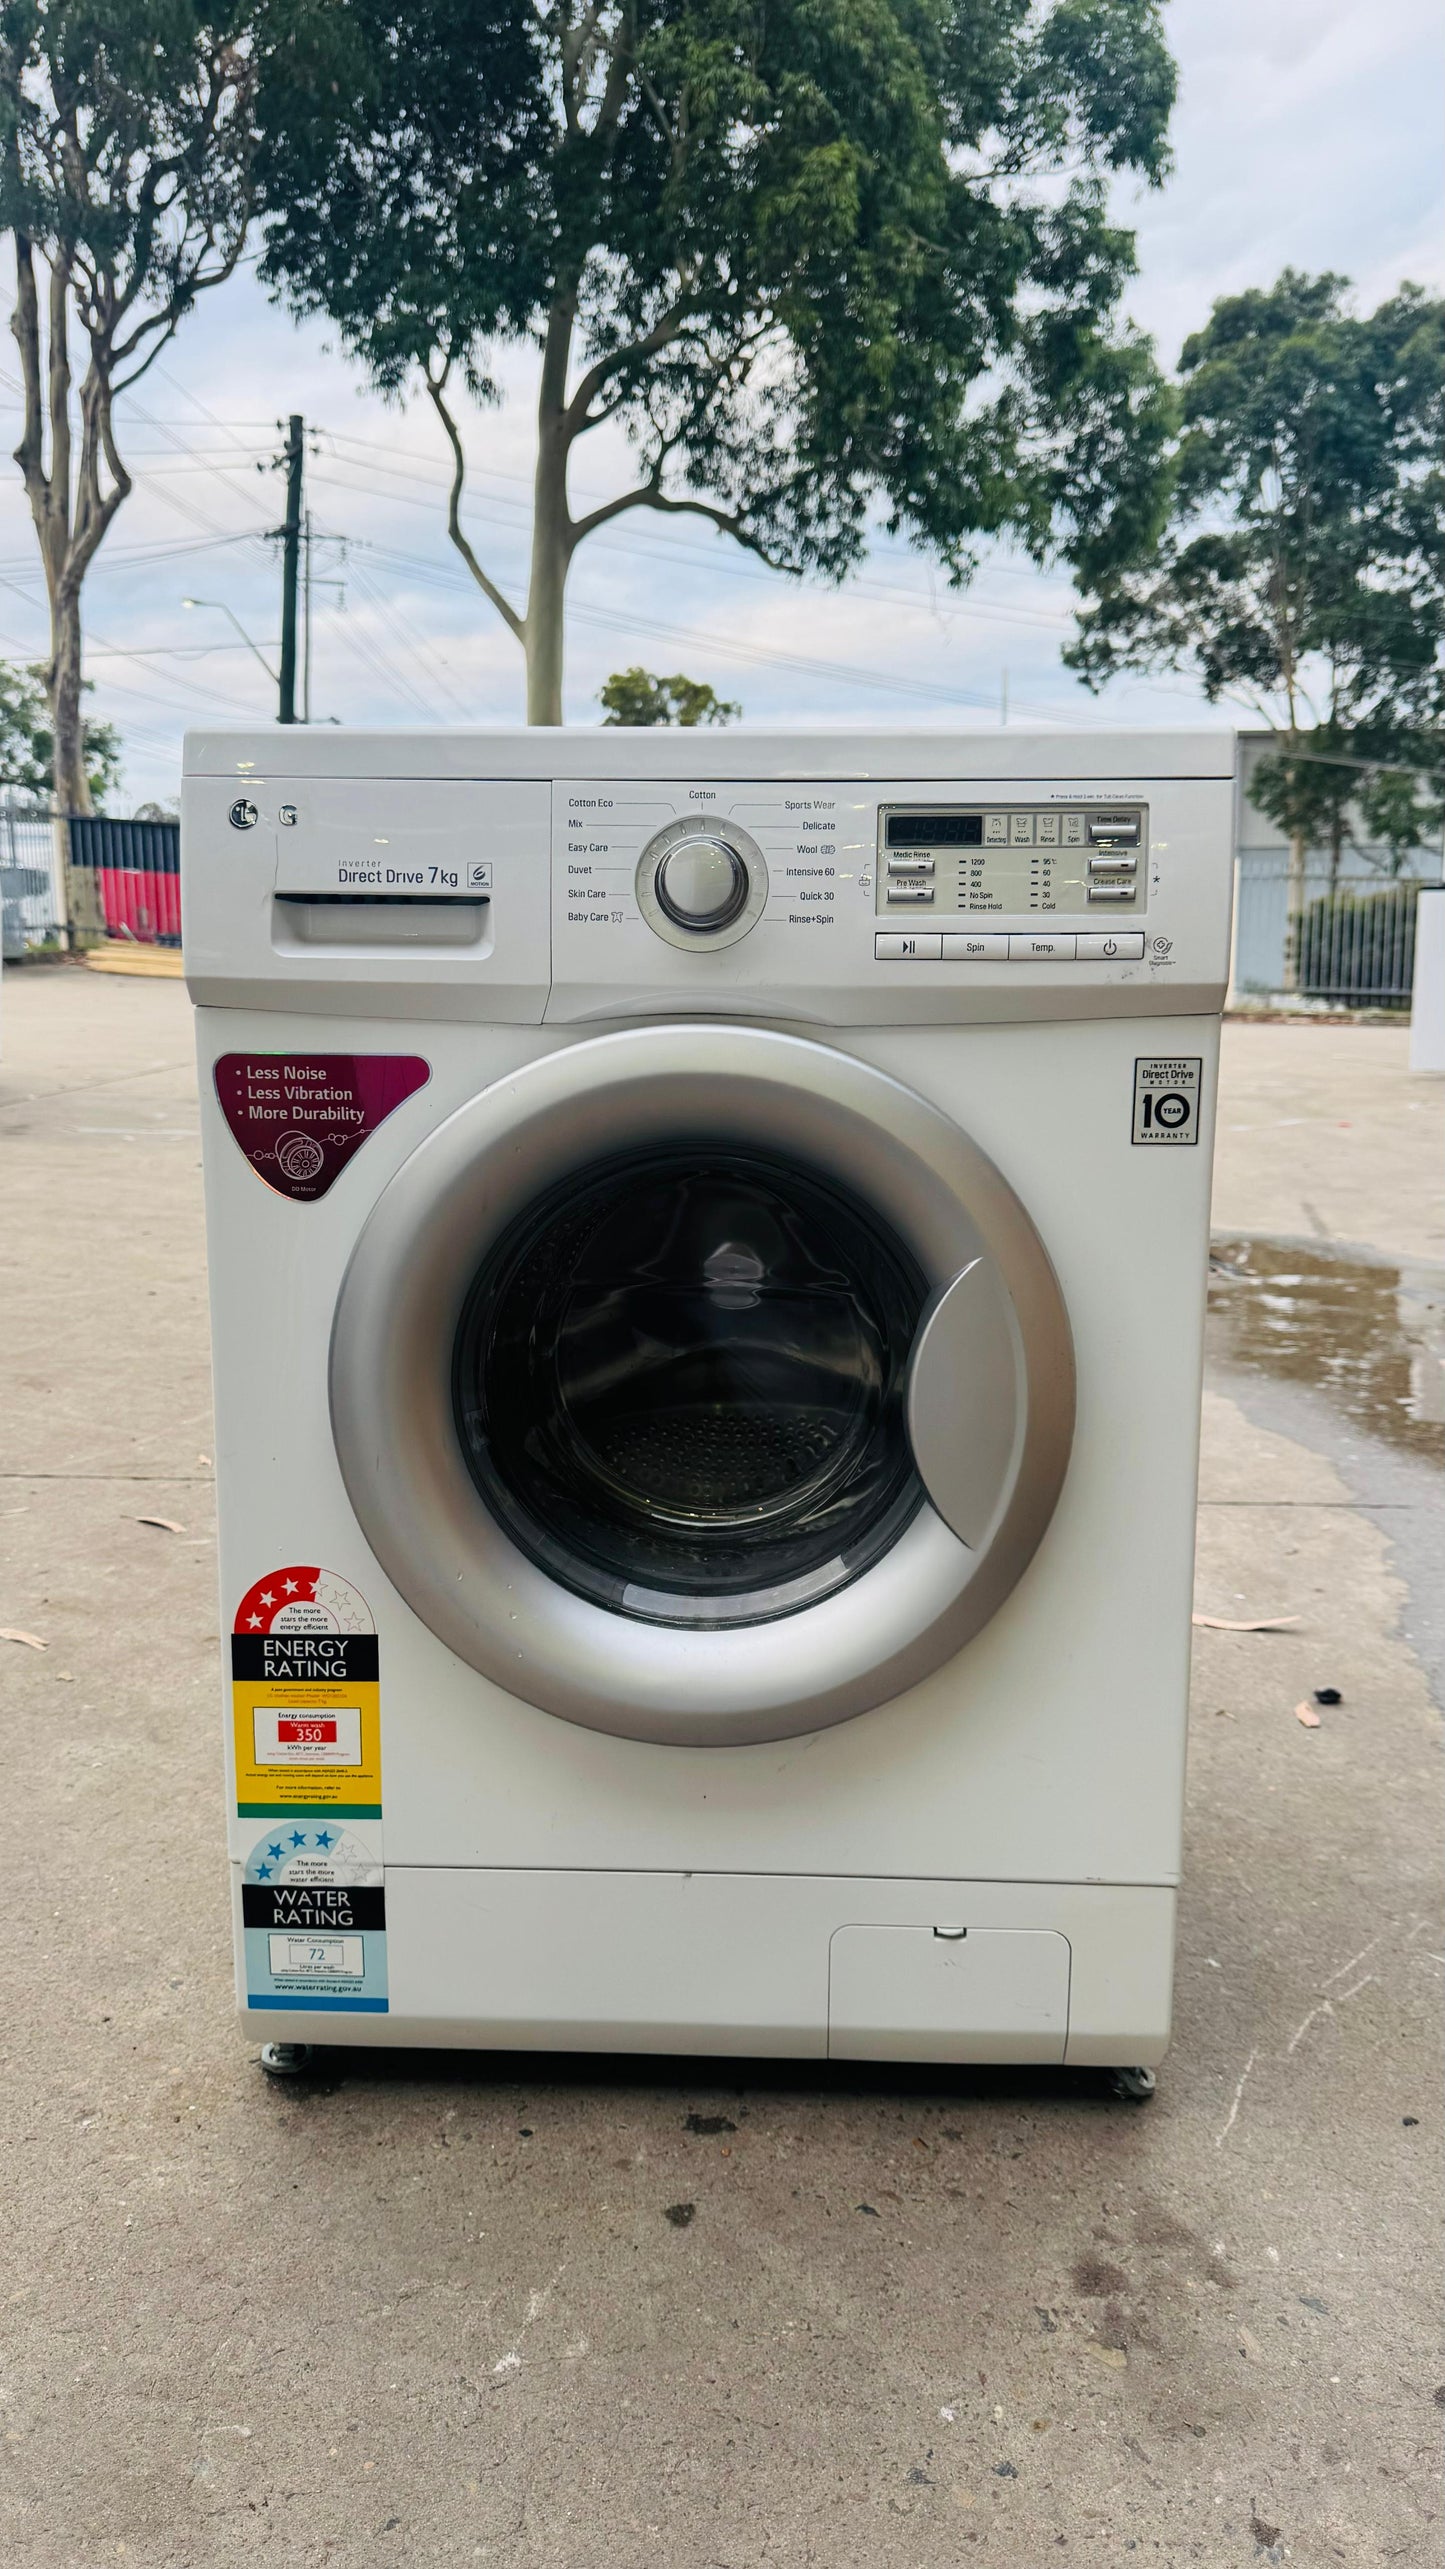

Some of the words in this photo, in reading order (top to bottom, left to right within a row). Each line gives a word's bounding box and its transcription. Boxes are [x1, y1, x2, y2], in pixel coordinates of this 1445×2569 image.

[689, 790, 716, 799] Cotton
[568, 799, 596, 808] Cotton
[598, 799, 613, 808] Eco
[785, 801, 812, 811] Sports
[813, 801, 835, 810] Wear
[568, 820, 583, 828] Mix
[1097, 815, 1112, 823] Time
[1113, 815, 1131, 824] Delay
[802, 821, 836, 831] Delicate
[568, 843, 588, 853] Easy
[589, 843, 608, 852] Care
[797, 845, 817, 854] Wool
[893, 851, 912, 859] Medic
[913, 851, 931, 859] Rinse
[568, 865, 592, 874] Duvet
[786, 867, 824, 877] Intensive
[824, 867, 835, 876] 60
[338, 868, 382, 883] Direct
[386, 868, 424, 884] Drive
[896, 879, 908, 887] Pre
[908, 879, 927, 887] Wash
[1093, 878, 1115, 886] Crease
[1116, 878, 1132, 886] Care
[568, 890, 585, 898] Skin
[587, 890, 606, 899] Care
[800, 892, 822, 901] Quick
[824, 892, 835, 901] 30
[1041, 902, 1056, 910] Cold
[568, 912, 588, 923] Baby
[590, 912, 609, 921] Care
[789, 914, 834, 924] Rinse+Spin
[966, 942, 985, 953] Spin
[1031, 942, 1056, 953] Temp.
[246, 1065, 279, 1080] Less
[284, 1065, 327, 1081] Noise
[1142, 1070, 1169, 1079] Direct
[1170, 1070, 1194, 1079] Drive
[247, 1085, 281, 1100] Less
[284, 1085, 353, 1101] Vibration
[249, 1106, 288, 1120] More
[292, 1106, 365, 1124] Durability
[1142, 1093, 1190, 1128] 10
[263, 1639, 349, 1657] ENERGY
[264, 1660, 347, 1677] RATING
[278, 1712, 297, 1720] Energy
[299, 1712, 336, 1720] consumption
[296, 1728, 322, 1742] 350
[273, 1890, 351, 1907] WATER
[273, 1908, 354, 1926] RATING
[309, 1948, 326, 1961] 72
[274, 1984, 362, 1993] www.waterrating.gov.au
